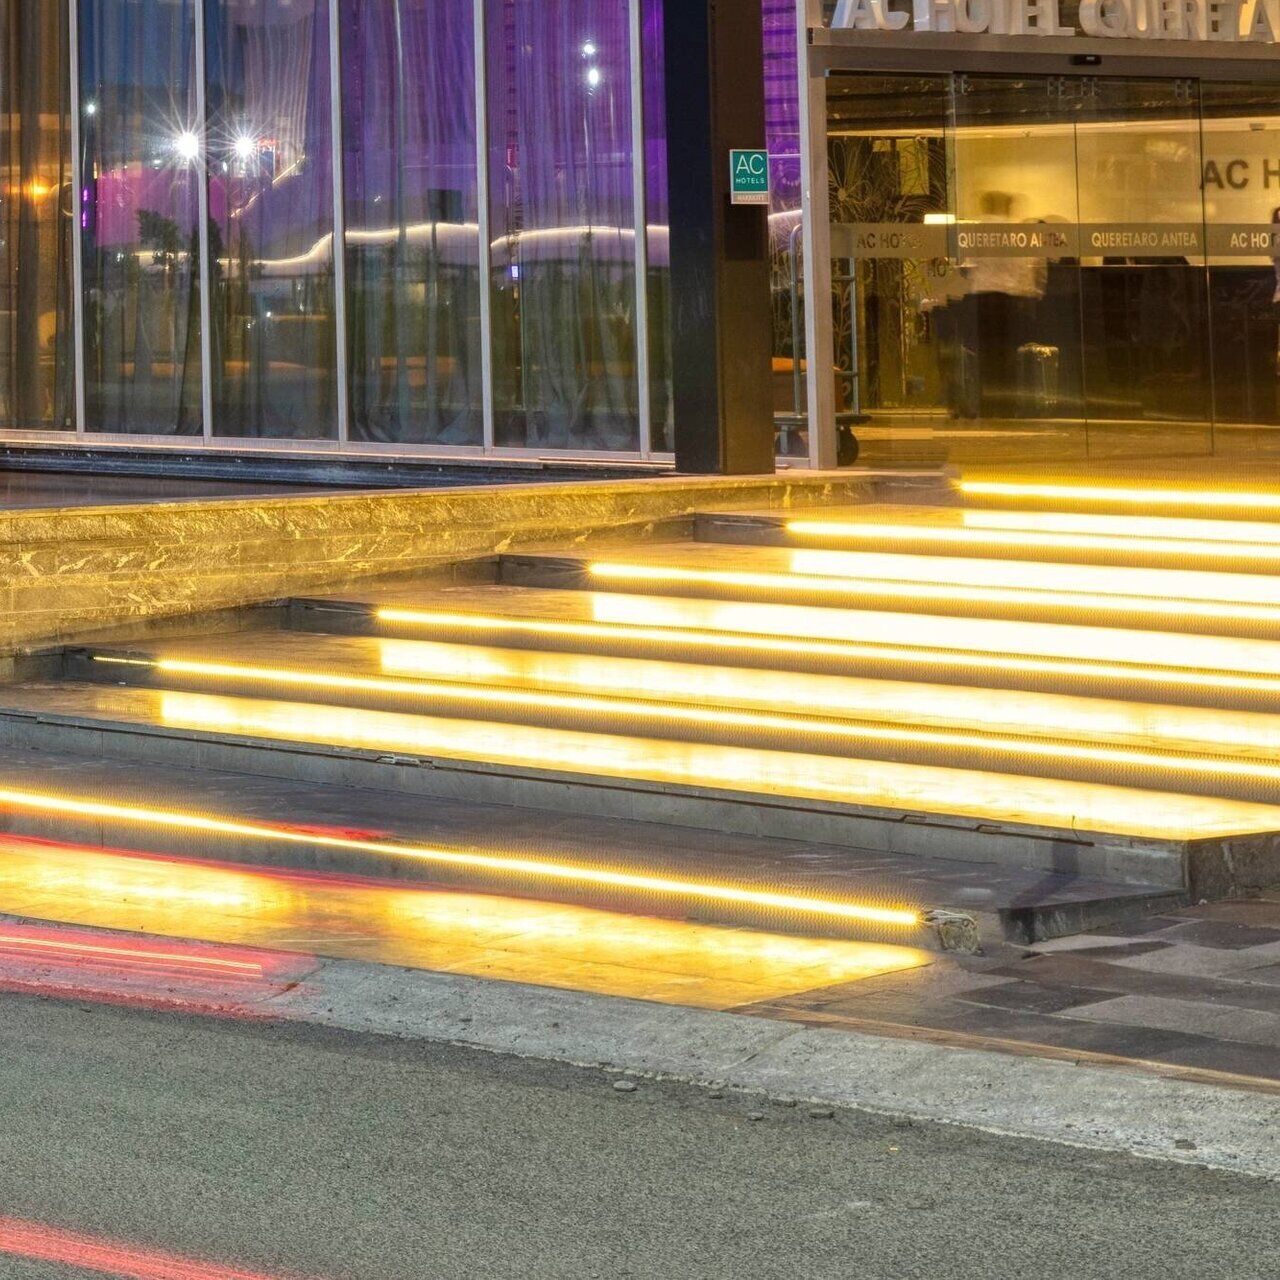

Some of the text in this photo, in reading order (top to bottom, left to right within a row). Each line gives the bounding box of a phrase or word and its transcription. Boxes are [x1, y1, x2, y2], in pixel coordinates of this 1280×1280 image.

[736, 154, 764, 174] AC
[1199, 159, 1249, 190] AC
[856, 232, 876, 249] AC
[957, 232, 1027, 249] QUERETARO
[1091, 232, 1199, 248] QUERETARO ANTEA
[1230, 232, 1248, 248] AC
